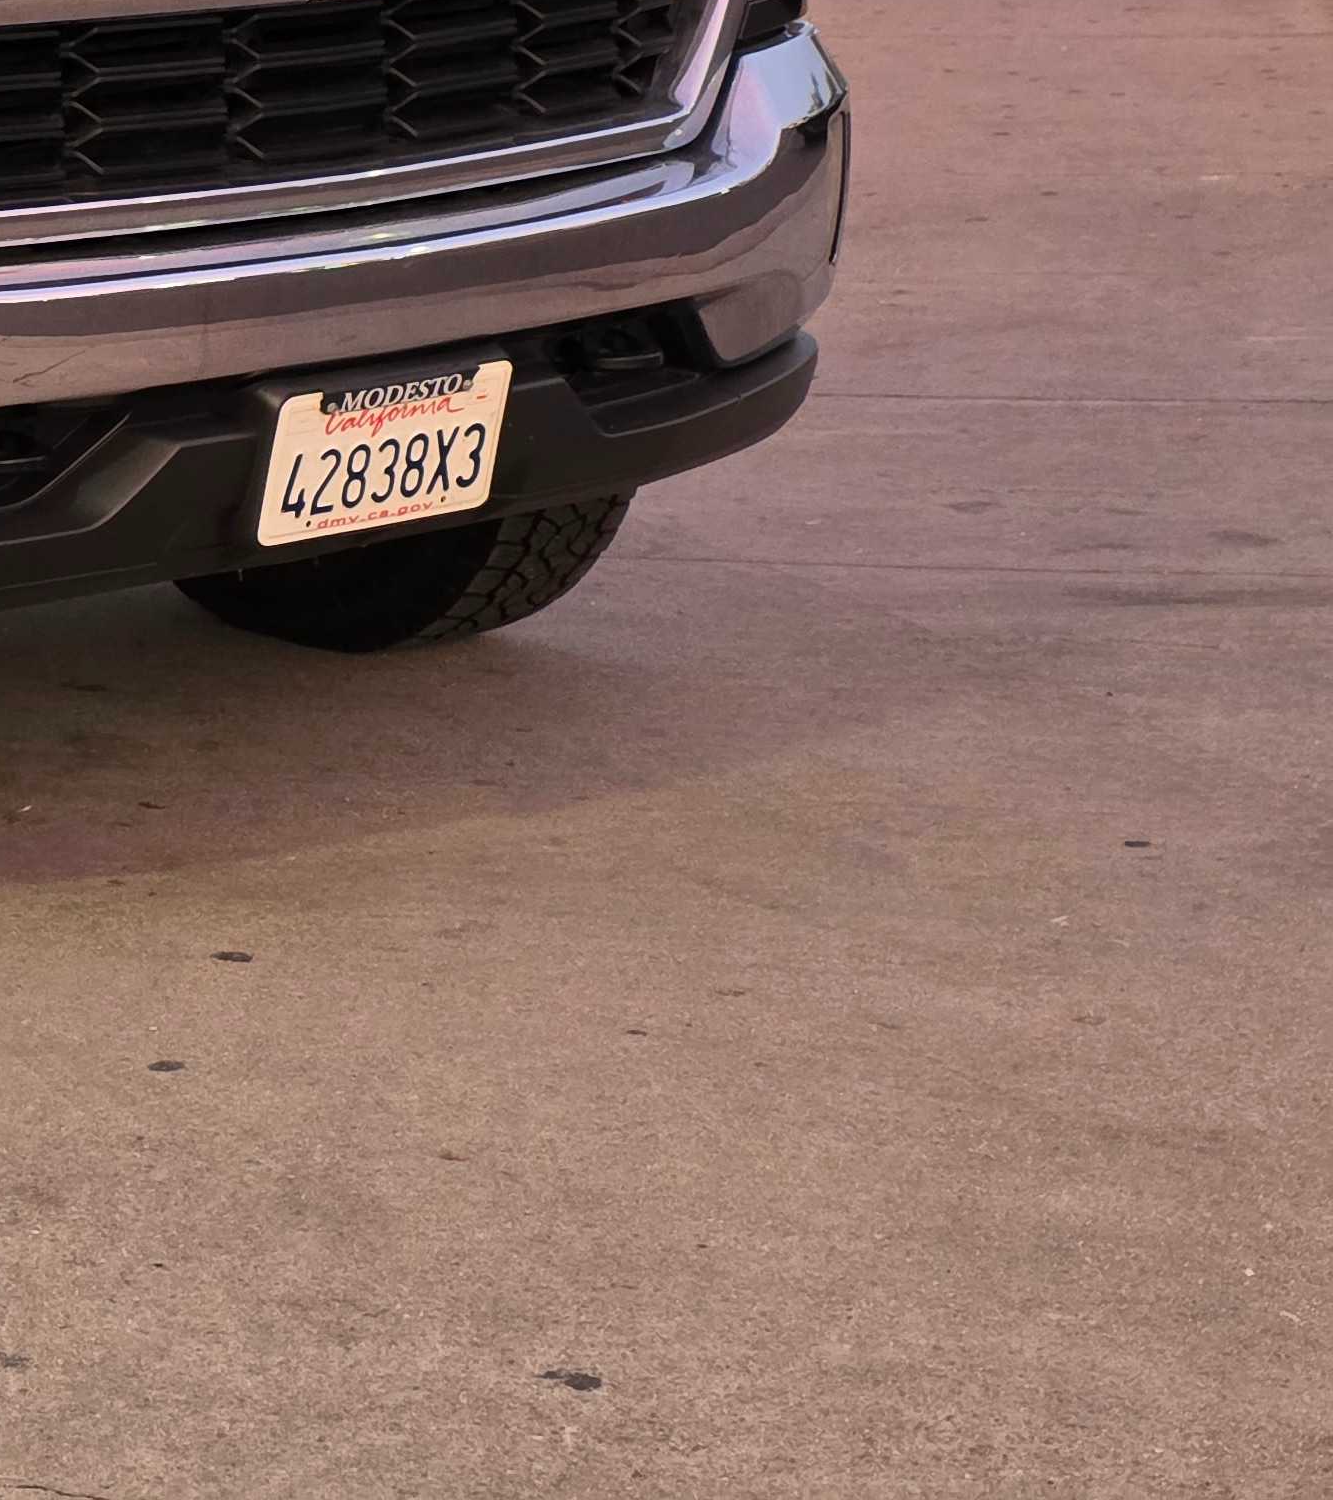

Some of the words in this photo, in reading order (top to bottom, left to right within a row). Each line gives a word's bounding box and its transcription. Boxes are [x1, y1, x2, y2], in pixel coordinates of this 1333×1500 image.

[339, 373, 463, 413] MODESTO
[325, 395, 464, 437] California
[280, 422, 487, 520] 42838X3
[316, 500, 434, 530] dmv.ca.gov
